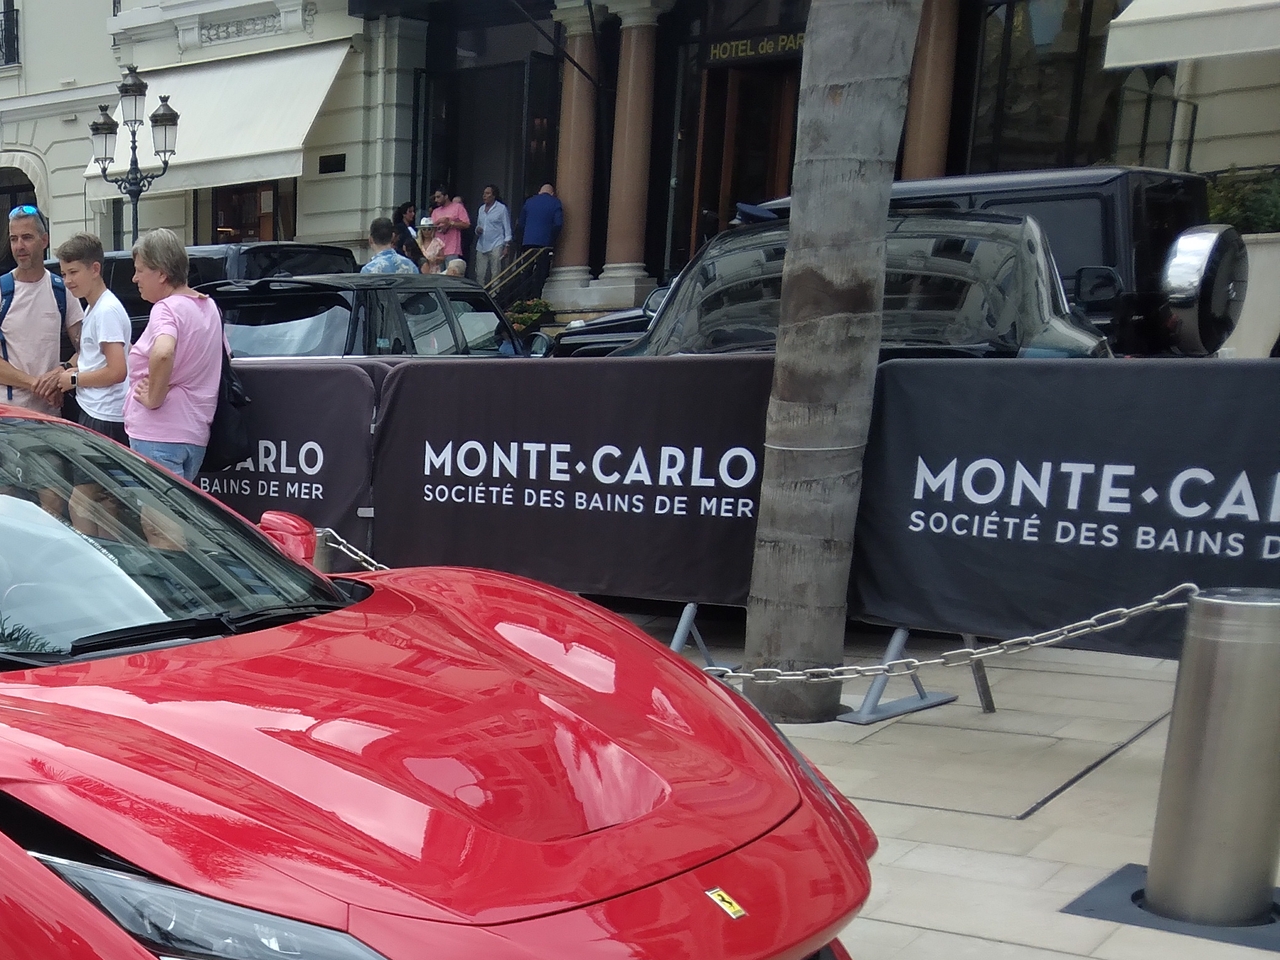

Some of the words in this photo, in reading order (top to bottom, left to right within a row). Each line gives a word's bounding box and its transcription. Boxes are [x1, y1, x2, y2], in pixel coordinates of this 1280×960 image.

[711, 40, 755, 60] HOTEL
[759, 38, 775, 54] de
[200, 477, 251, 495] BAINS
[258, 481, 280, 497] DE
[286, 482, 324, 499] MER
[423, 482, 514, 505] SOCIÉTÉ
[524, 488, 565, 508] DES
[575, 491, 644, 514] BAINS
[654, 495, 687, 515] DE
[700, 497, 754, 518] MER
[908, 510, 1041, 541] SOCIÉTÉ
[1055, 521, 1119, 547] DES
[1136, 526, 1245, 557] BAINS
